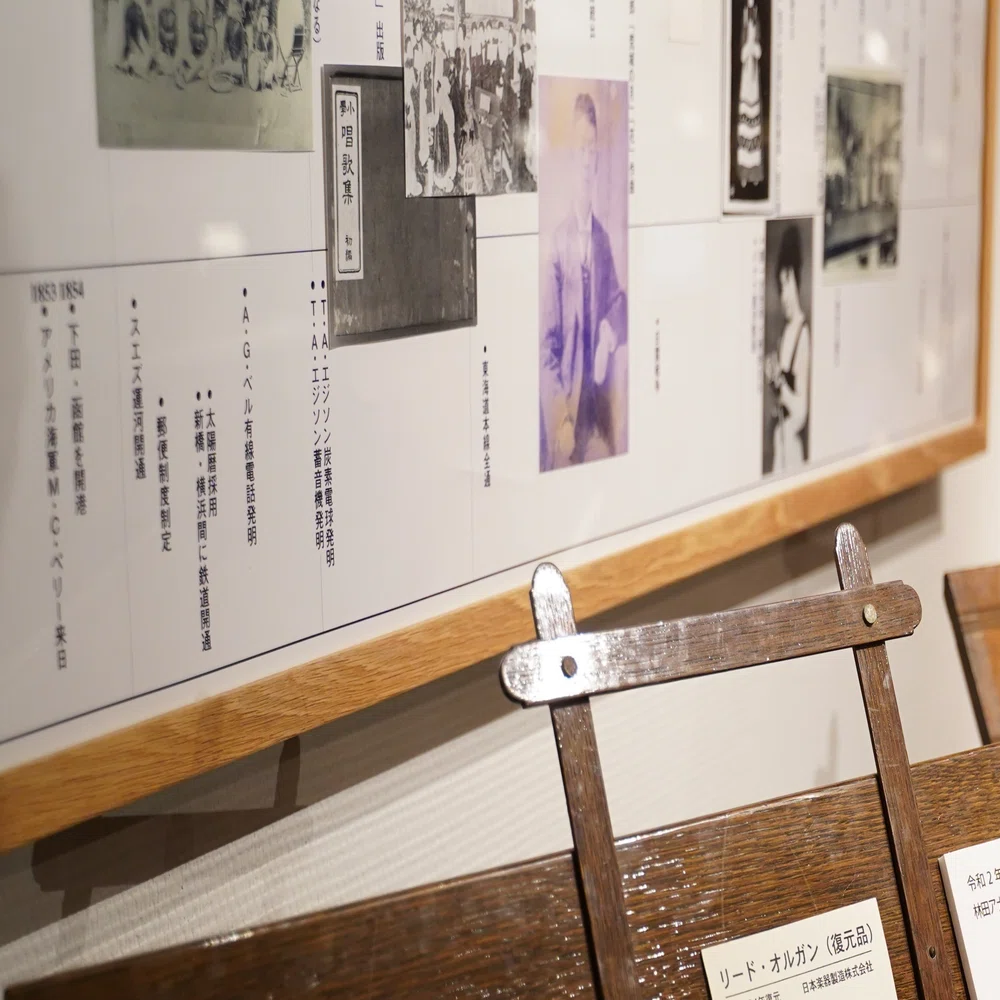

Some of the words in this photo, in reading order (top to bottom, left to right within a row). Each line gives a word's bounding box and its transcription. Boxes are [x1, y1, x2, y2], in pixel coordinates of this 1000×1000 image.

[59, 280, 85, 301] 1854
[802, 960, 874, 994] 日本楽器製造株式会社
